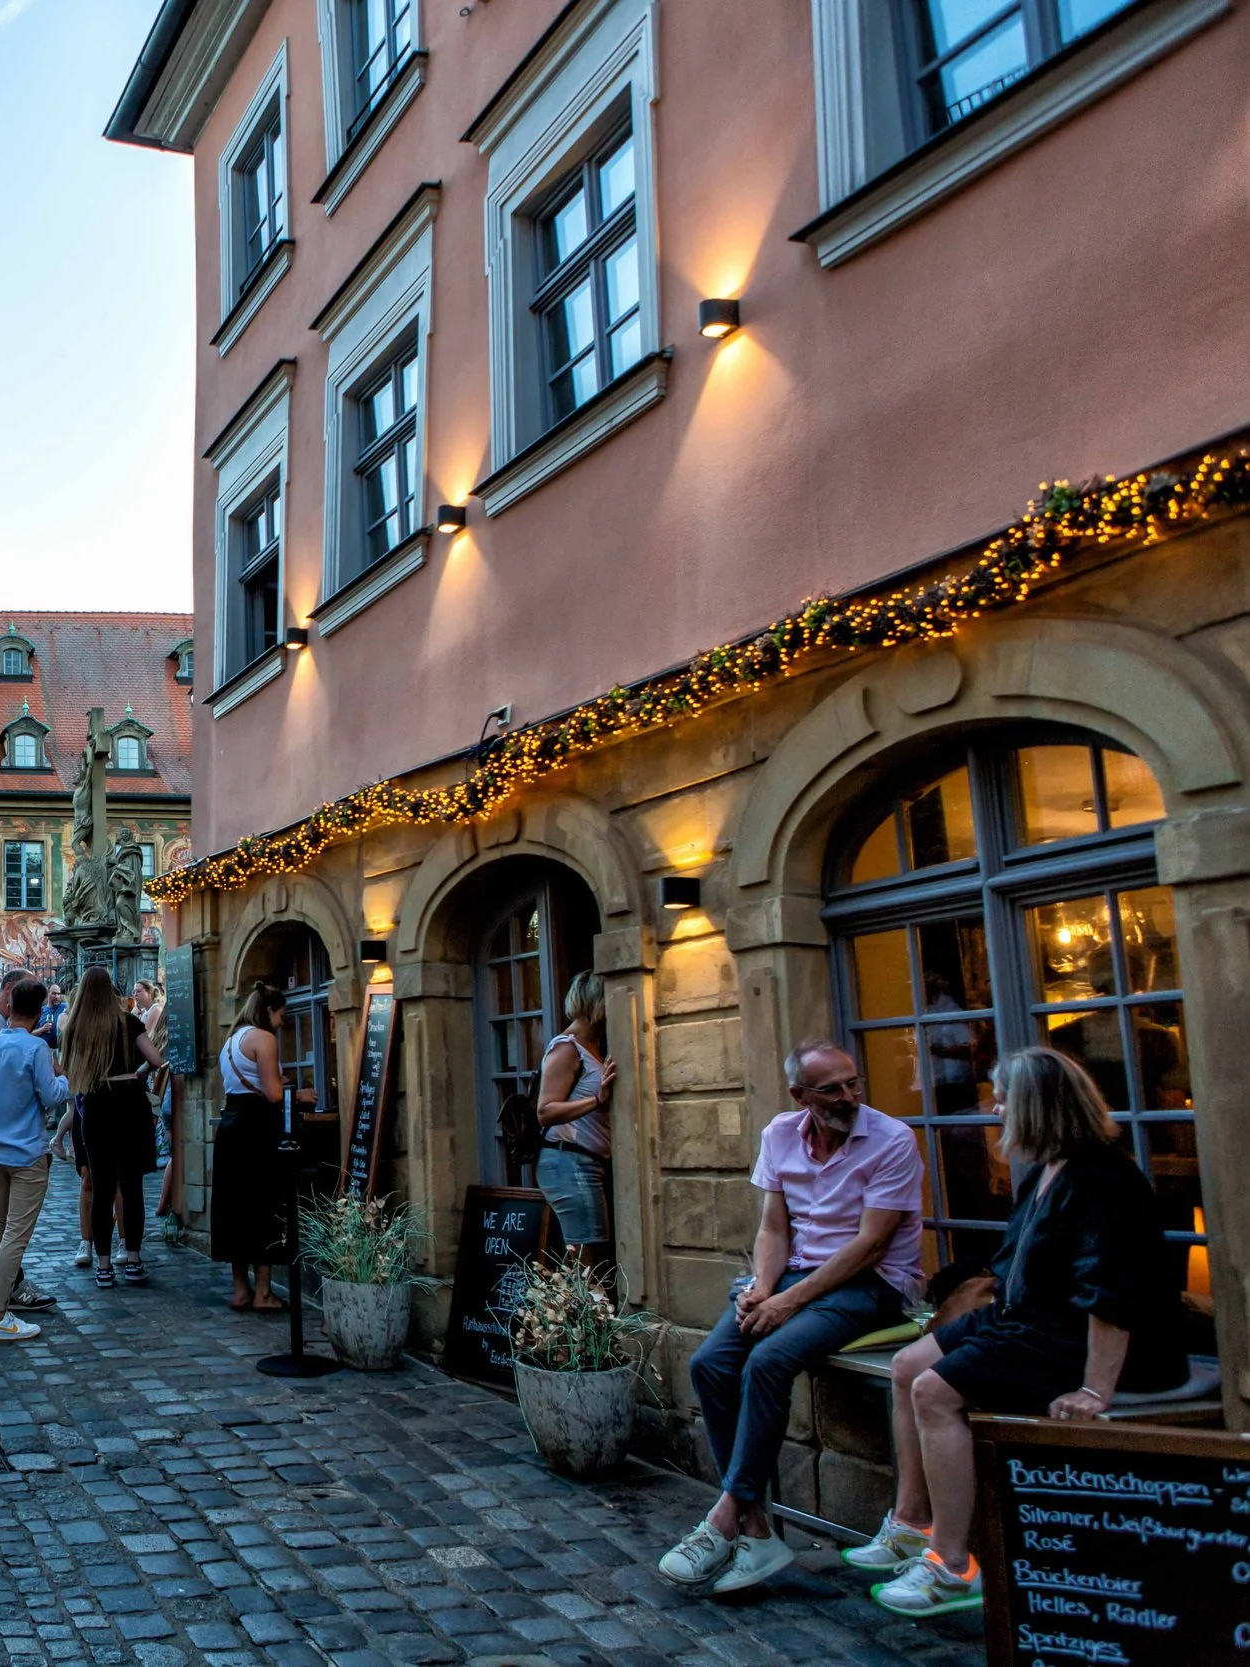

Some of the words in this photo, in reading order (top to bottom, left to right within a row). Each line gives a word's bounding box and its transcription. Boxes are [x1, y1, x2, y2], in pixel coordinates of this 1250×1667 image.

[483, 1211, 498, 1229] WE
[502, 1213, 526, 1231] ARE
[485, 1237, 508, 1256] OPEN
[18, 1292, 31, 1302] N
[1024, 1531, 1077, 1552] Rosé
[1013, 1559, 1143, 1592] Brückenbier
[1106, 1603, 1178, 1629] Radler
[1018, 1624, 1123, 1660] Spritziges
